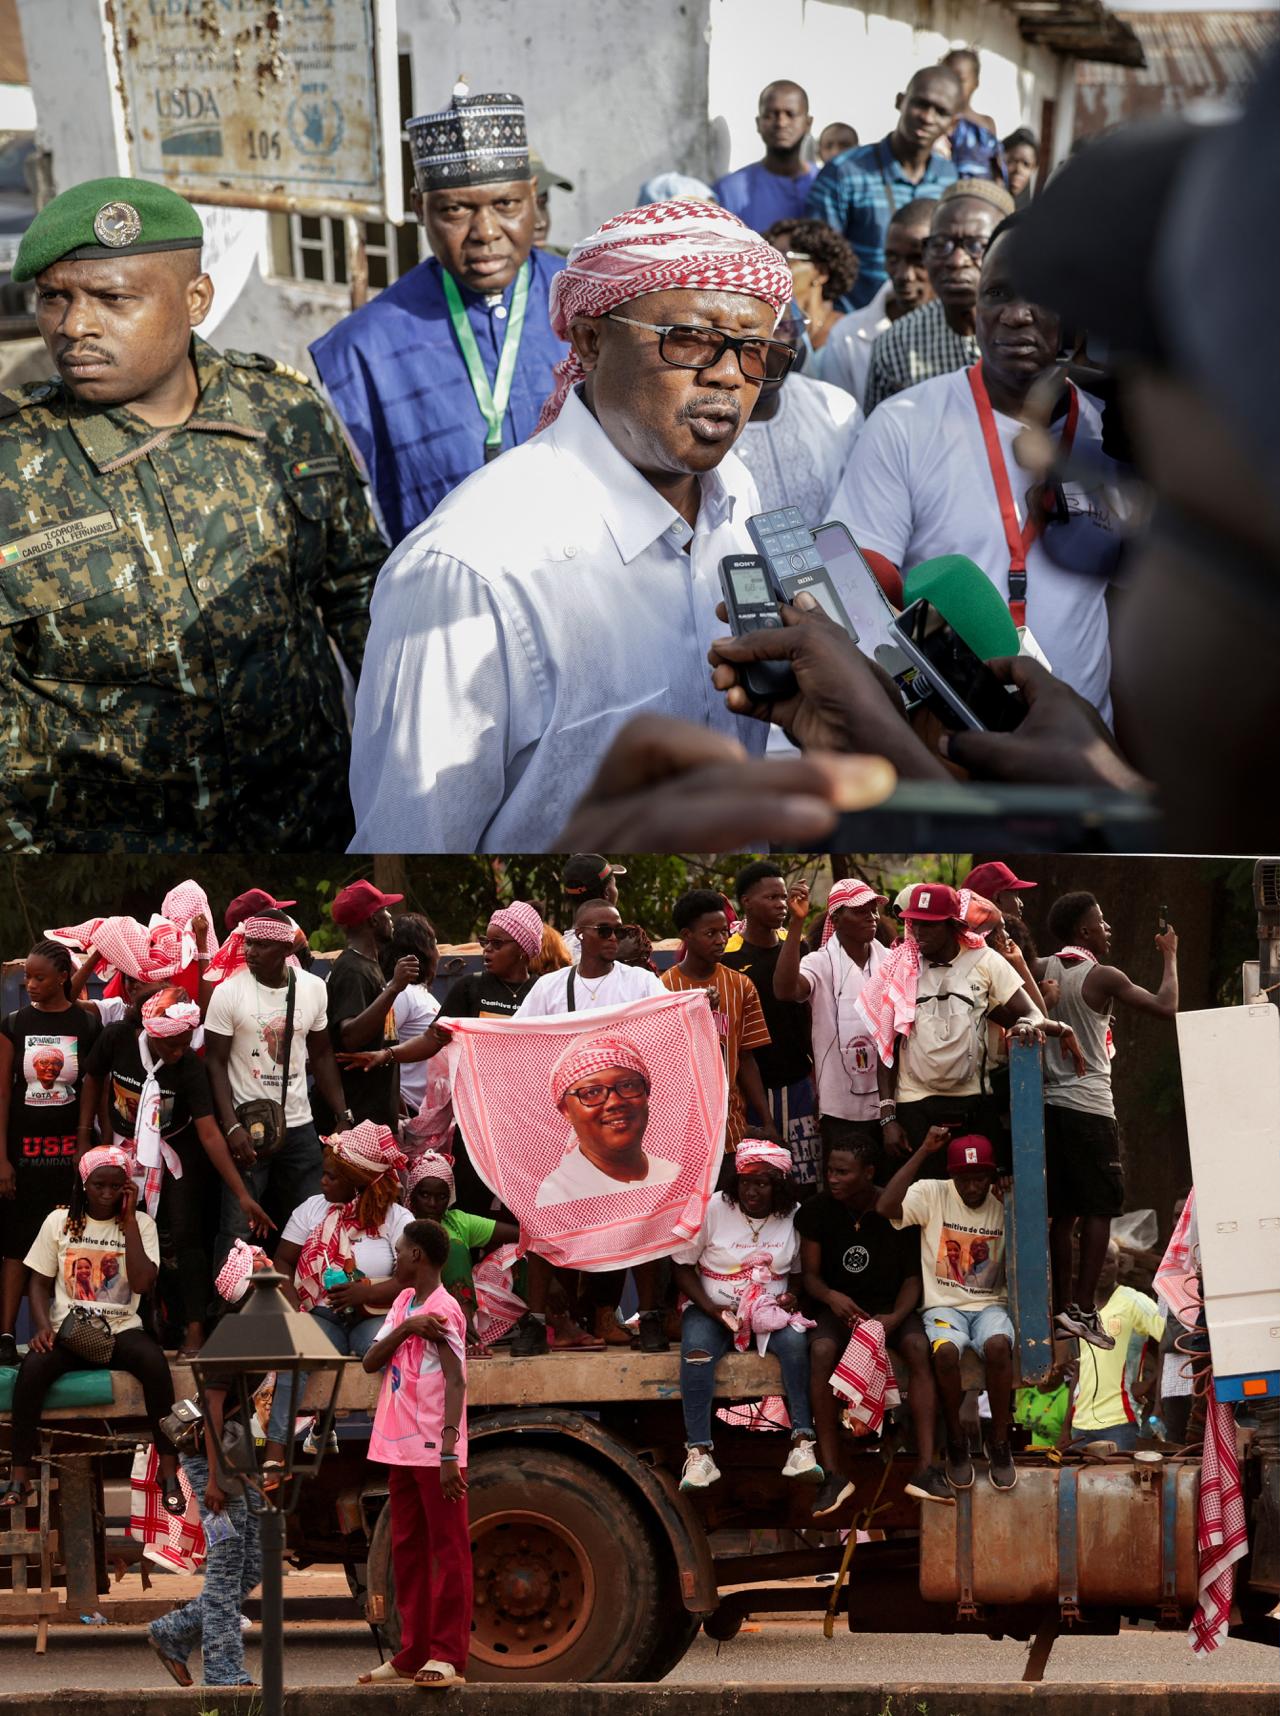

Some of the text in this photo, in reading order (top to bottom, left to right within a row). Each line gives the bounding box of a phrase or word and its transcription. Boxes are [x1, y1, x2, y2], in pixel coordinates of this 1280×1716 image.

[156, 88, 220, 119] USDA
[22, 540, 53, 558] CARLOS
[70, 521, 114, 542] FERNANDES
[44, 521, 87, 541] T.CORONEL
[22, 1135, 78, 1157] USE
